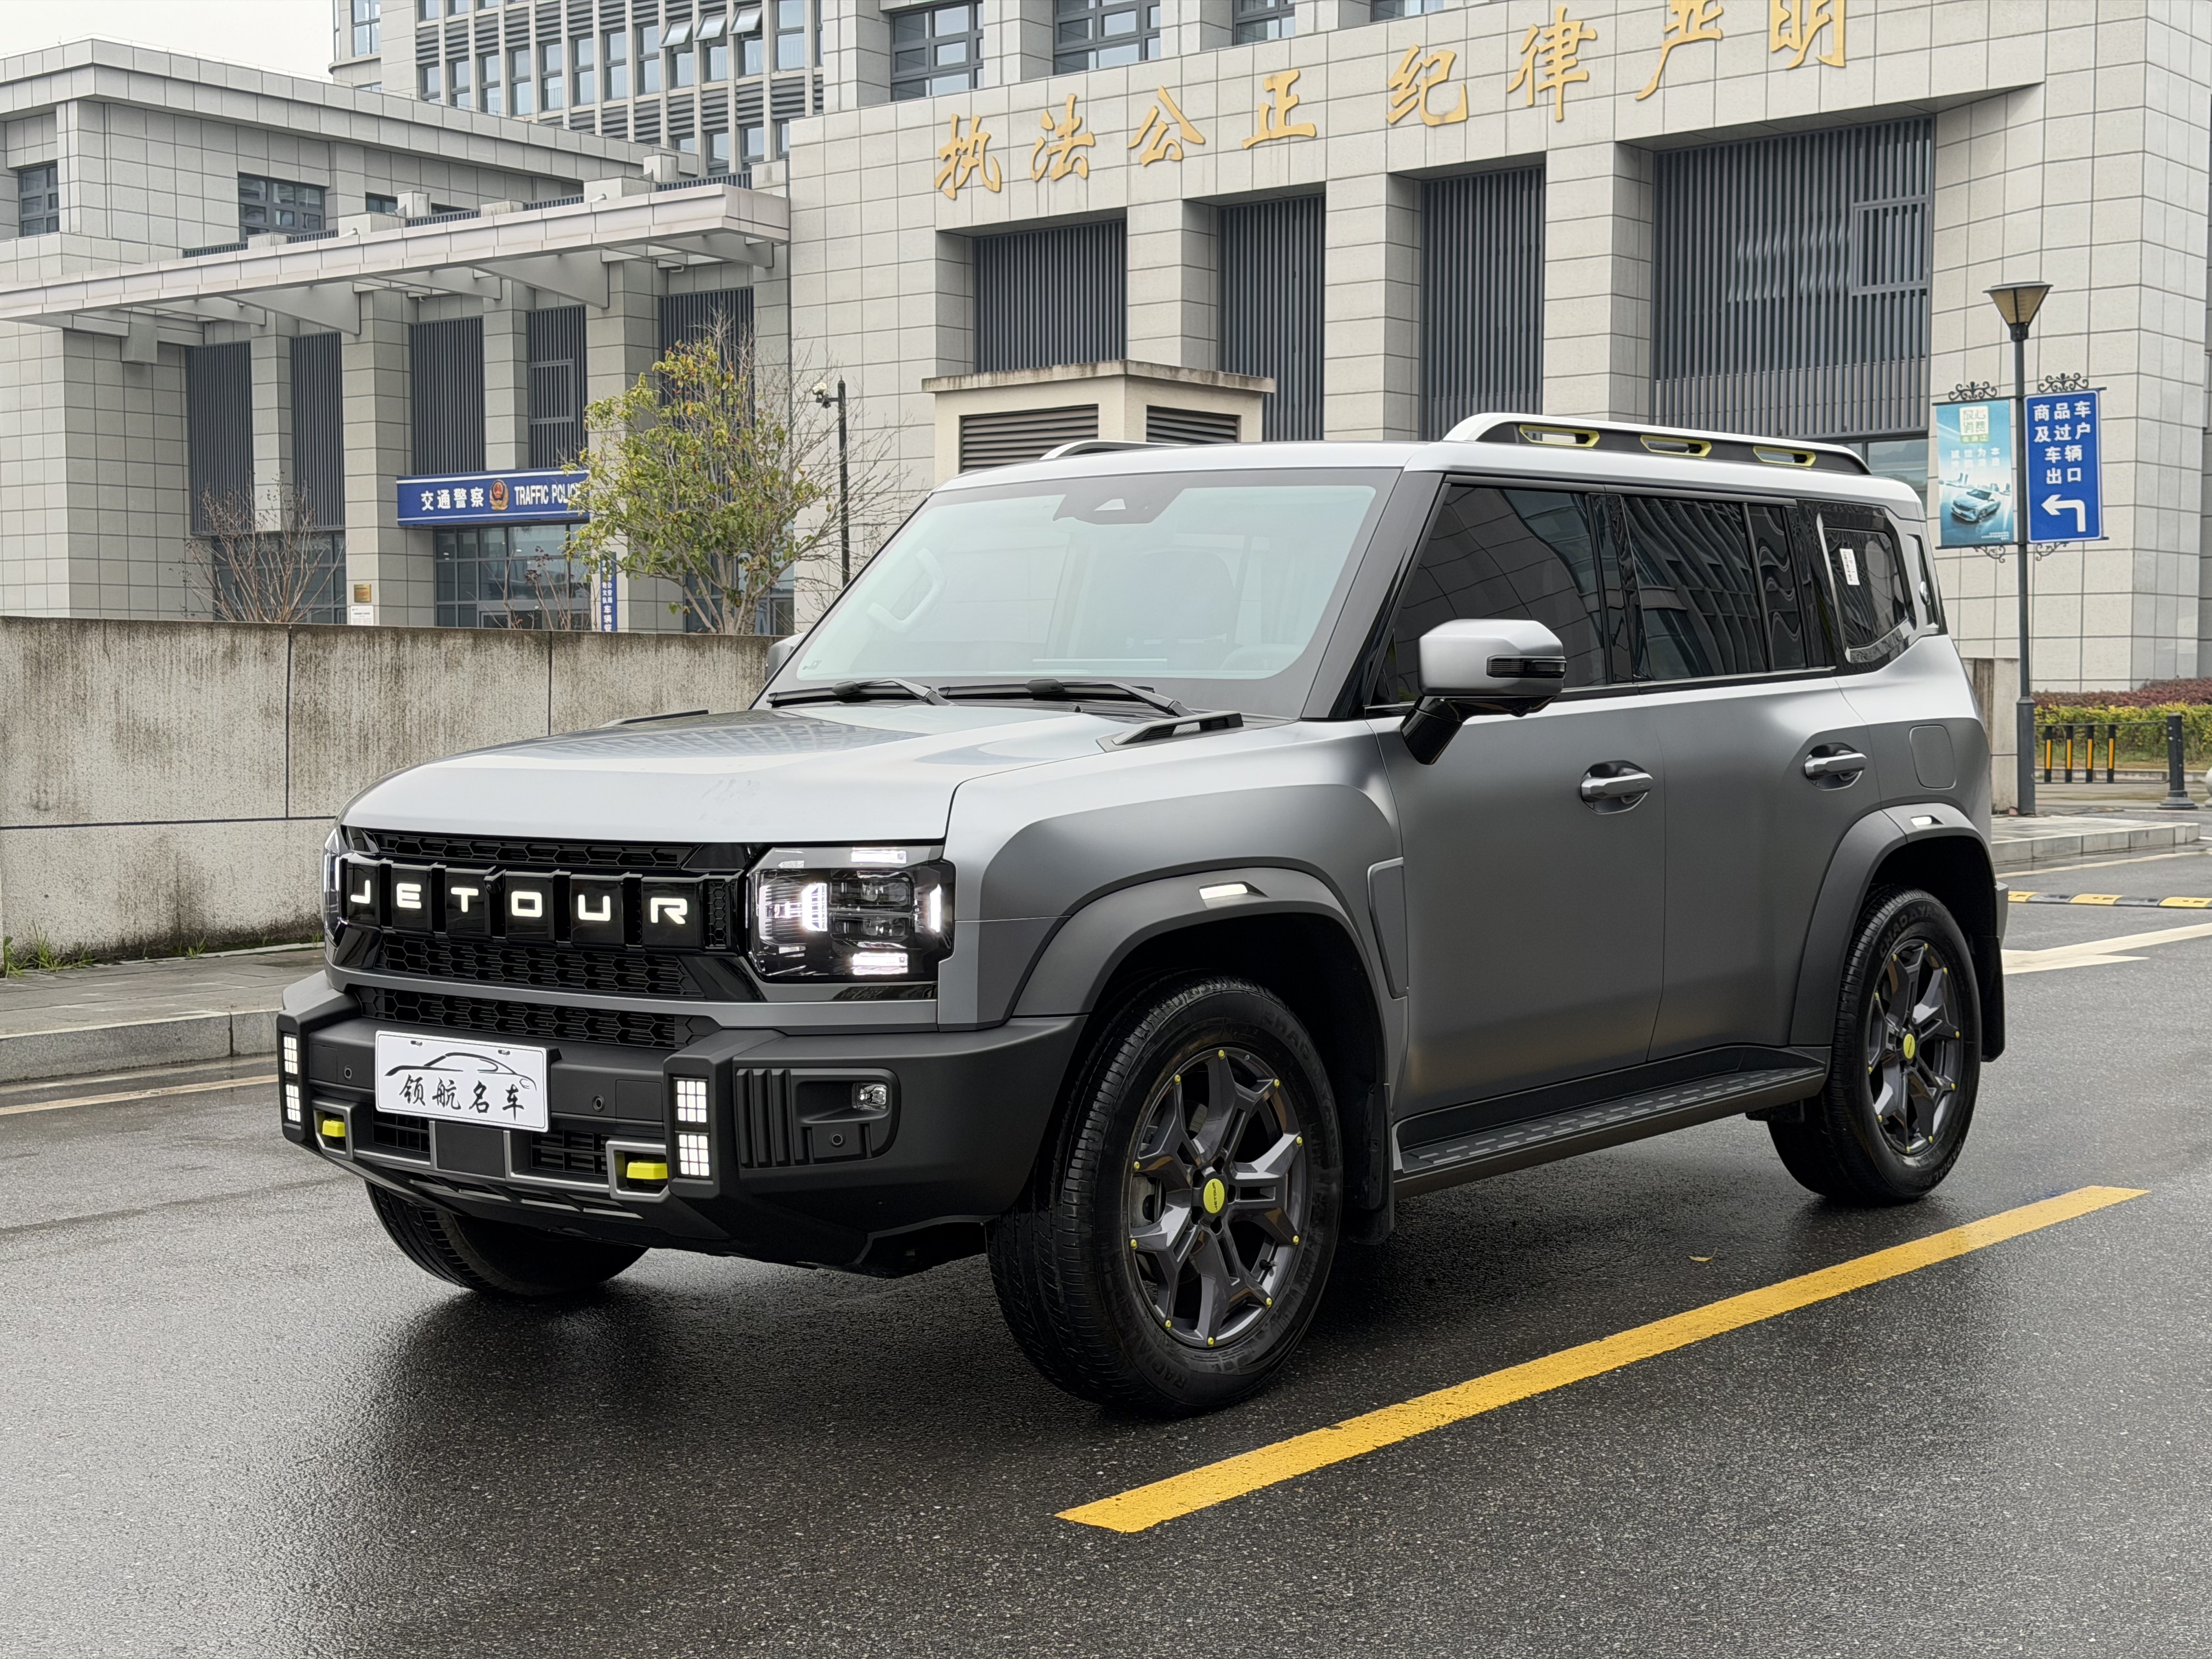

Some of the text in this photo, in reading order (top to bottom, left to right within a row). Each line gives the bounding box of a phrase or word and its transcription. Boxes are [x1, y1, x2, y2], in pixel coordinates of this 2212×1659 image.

[934, 69, 1317, 200] 执法公正
[2033, 400, 2091, 422] 商品车
[2034, 422, 2091, 443] 及过户
[2045, 445, 2083, 464] 车辆
[2046, 467, 2081, 484] 出口
[421, 487, 484, 511] 交通警察
[514, 484, 549, 506] TRAFFIC
[350, 879, 688, 924] JETOUR
[399, 1074, 525, 1121] 领航名车
